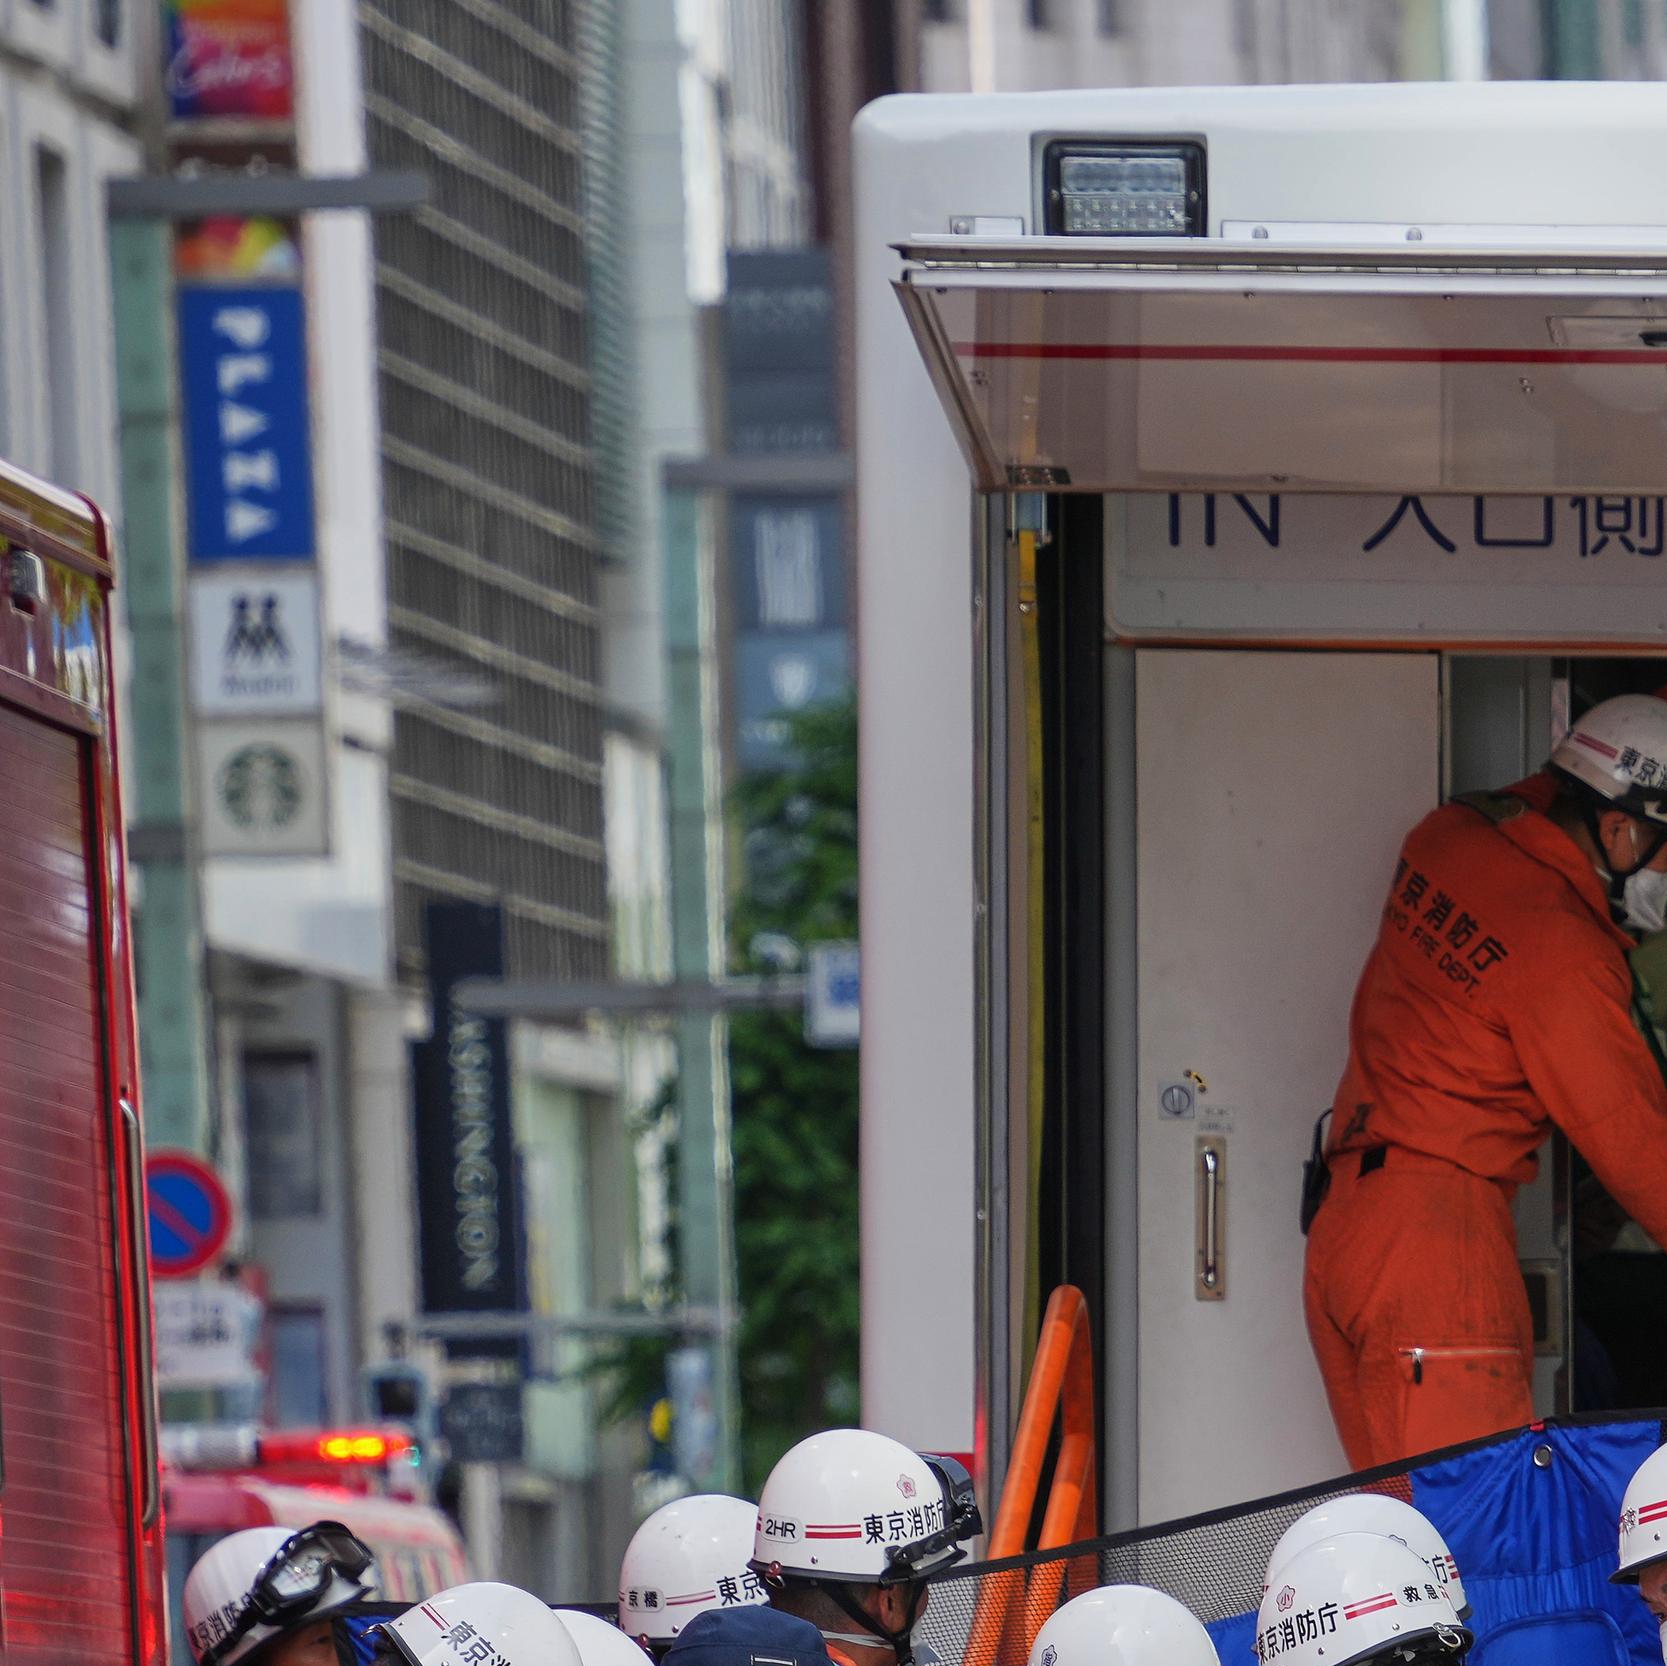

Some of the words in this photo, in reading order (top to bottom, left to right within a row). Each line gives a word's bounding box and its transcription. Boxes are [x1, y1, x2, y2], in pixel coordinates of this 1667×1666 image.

[211, 305, 281, 545] PLAZA
[1410, 925, 1441, 959] FIRE
[1437, 952, 1481, 998] DEPT.
[449, 1003, 498, 1290] ASHINGTON
[765, 1518, 797, 1540] 2HR
[1422, 1554, 1449, 1585] 庁
[628, 1590, 658, 1609] 京橋
[1402, 1583, 1440, 1604] 救急
[1257, 1602, 1339, 1666] 東京消防庁
